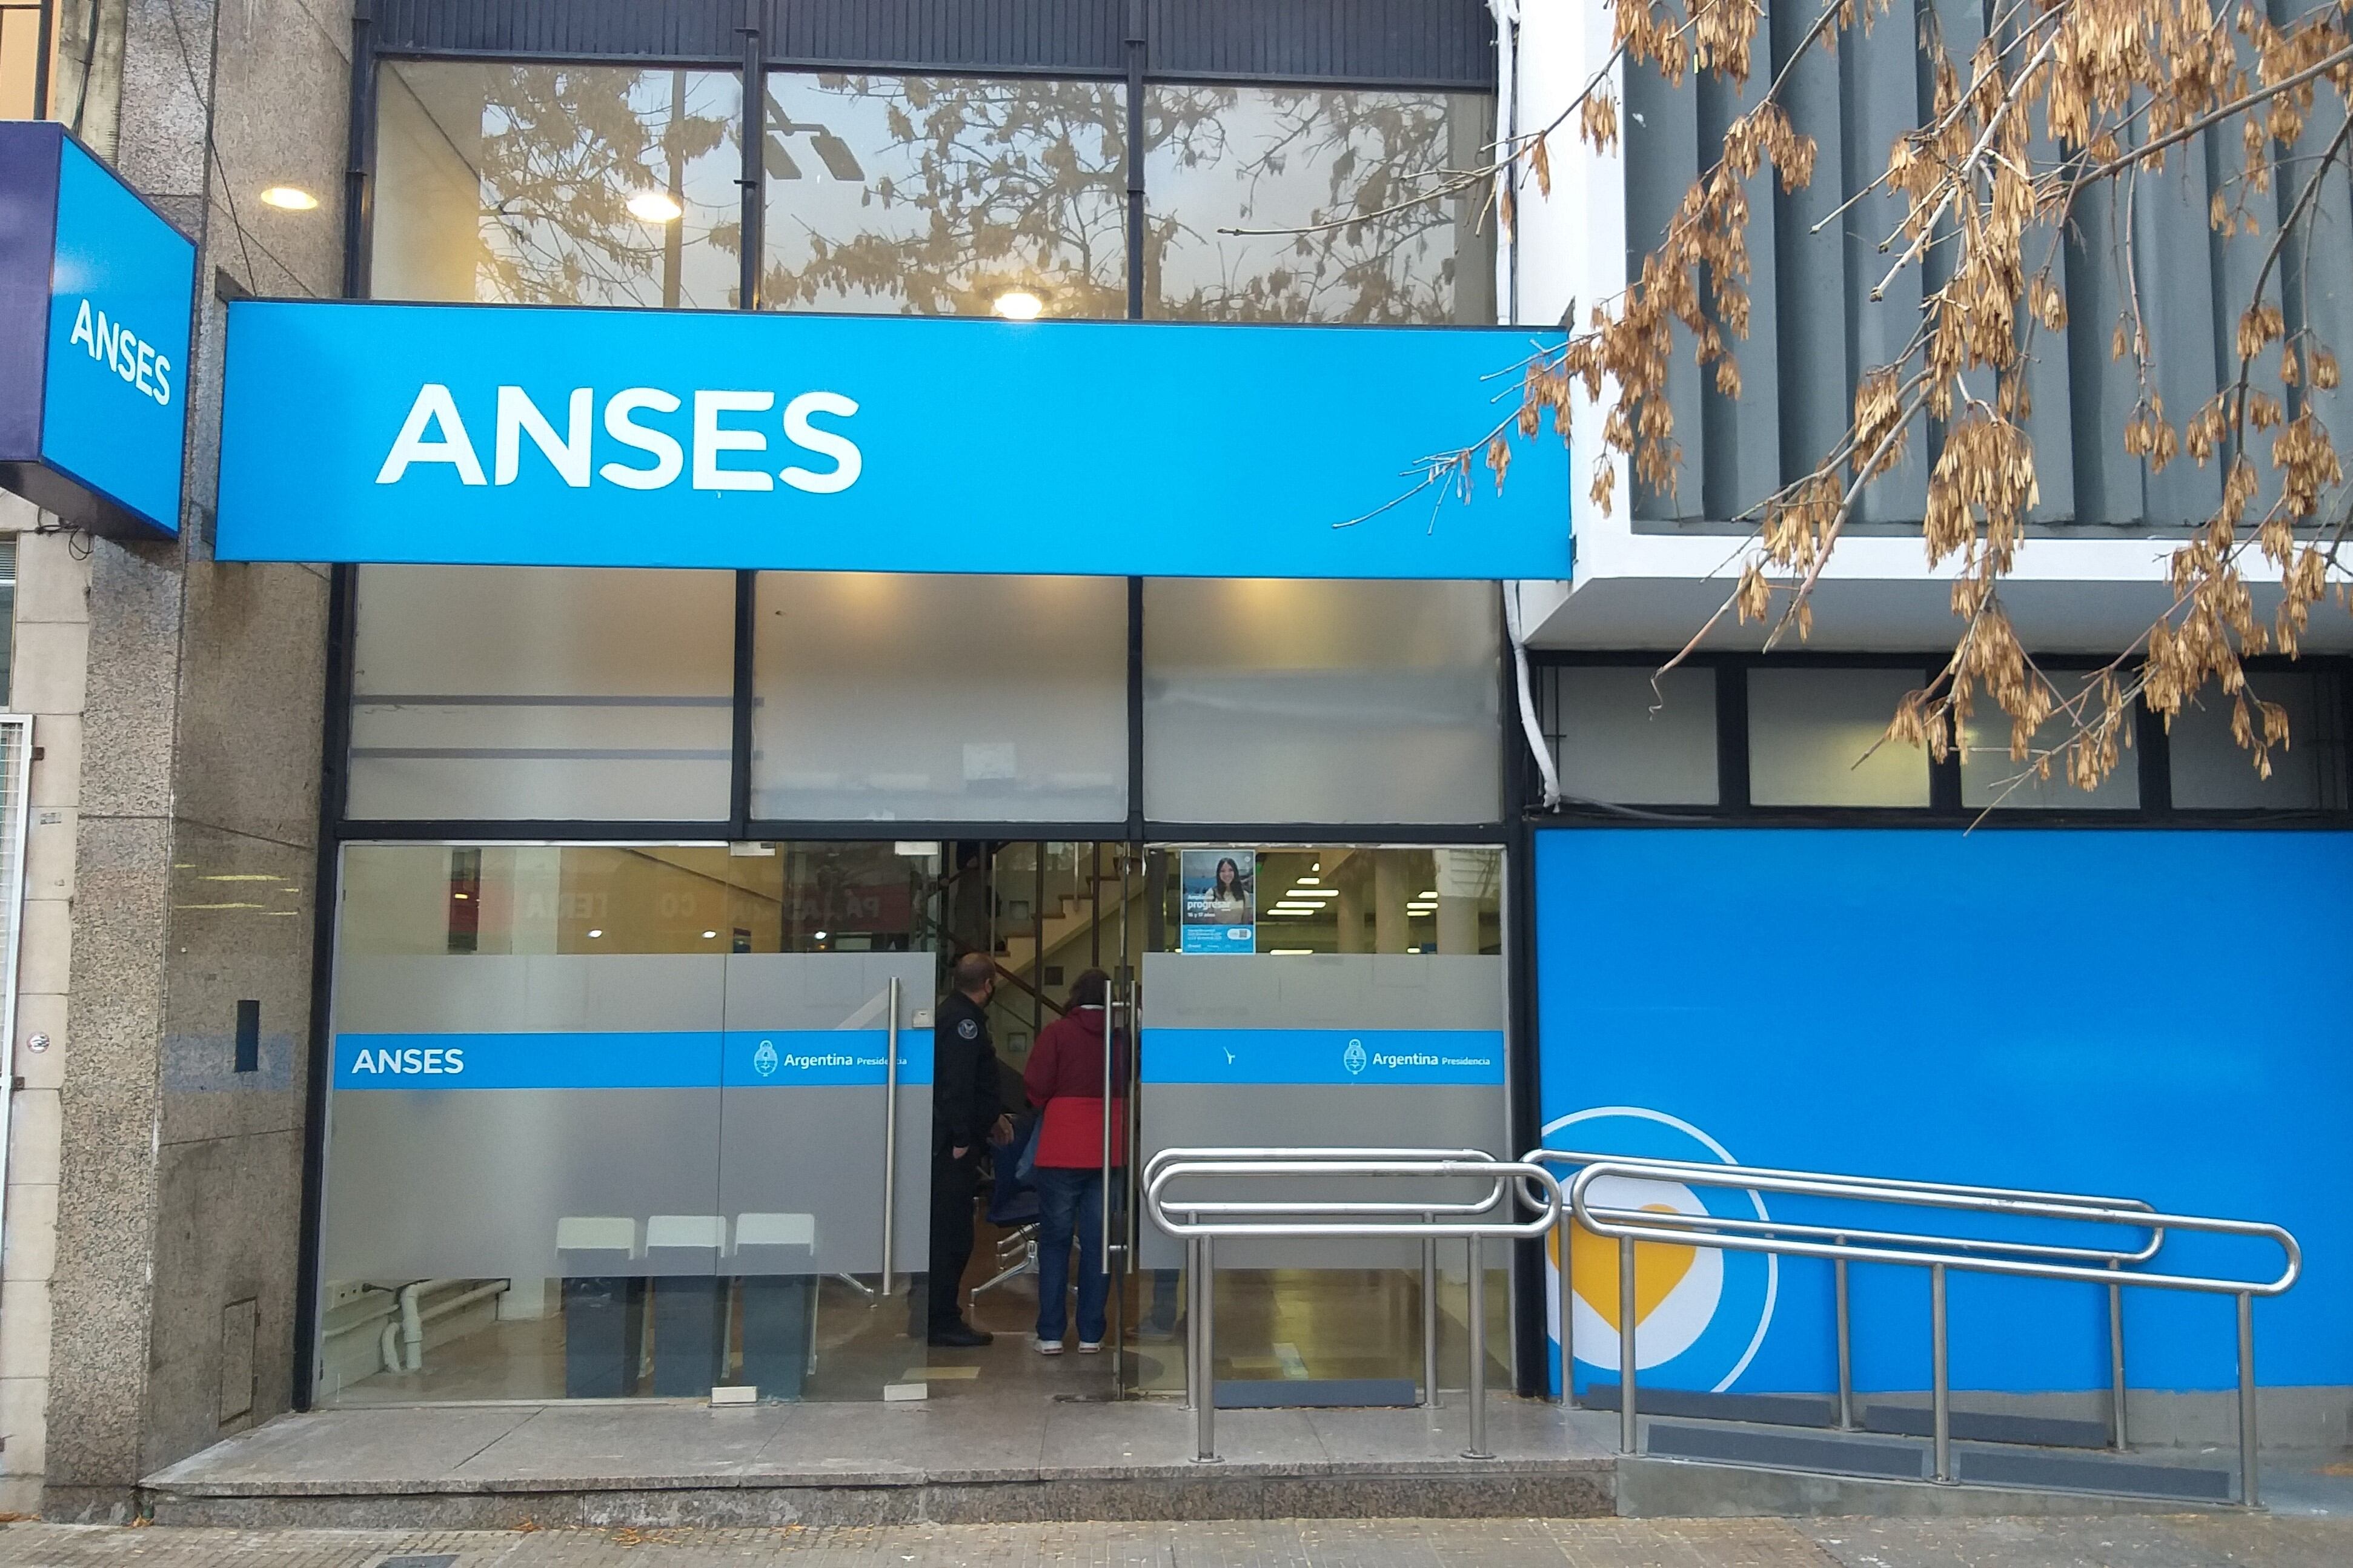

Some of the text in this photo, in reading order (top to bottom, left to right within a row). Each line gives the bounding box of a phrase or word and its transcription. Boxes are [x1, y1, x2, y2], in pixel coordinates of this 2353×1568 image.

[70, 298, 171, 406] ANSES
[374, 383, 863, 494] ANSES
[1187, 901, 1232, 910] progresar
[351, 1048, 465, 1074] ANSES
[783, 1053, 908, 1070] Argentina Presidecia
[1372, 1053, 1490, 1068] Argentina Presidencia
